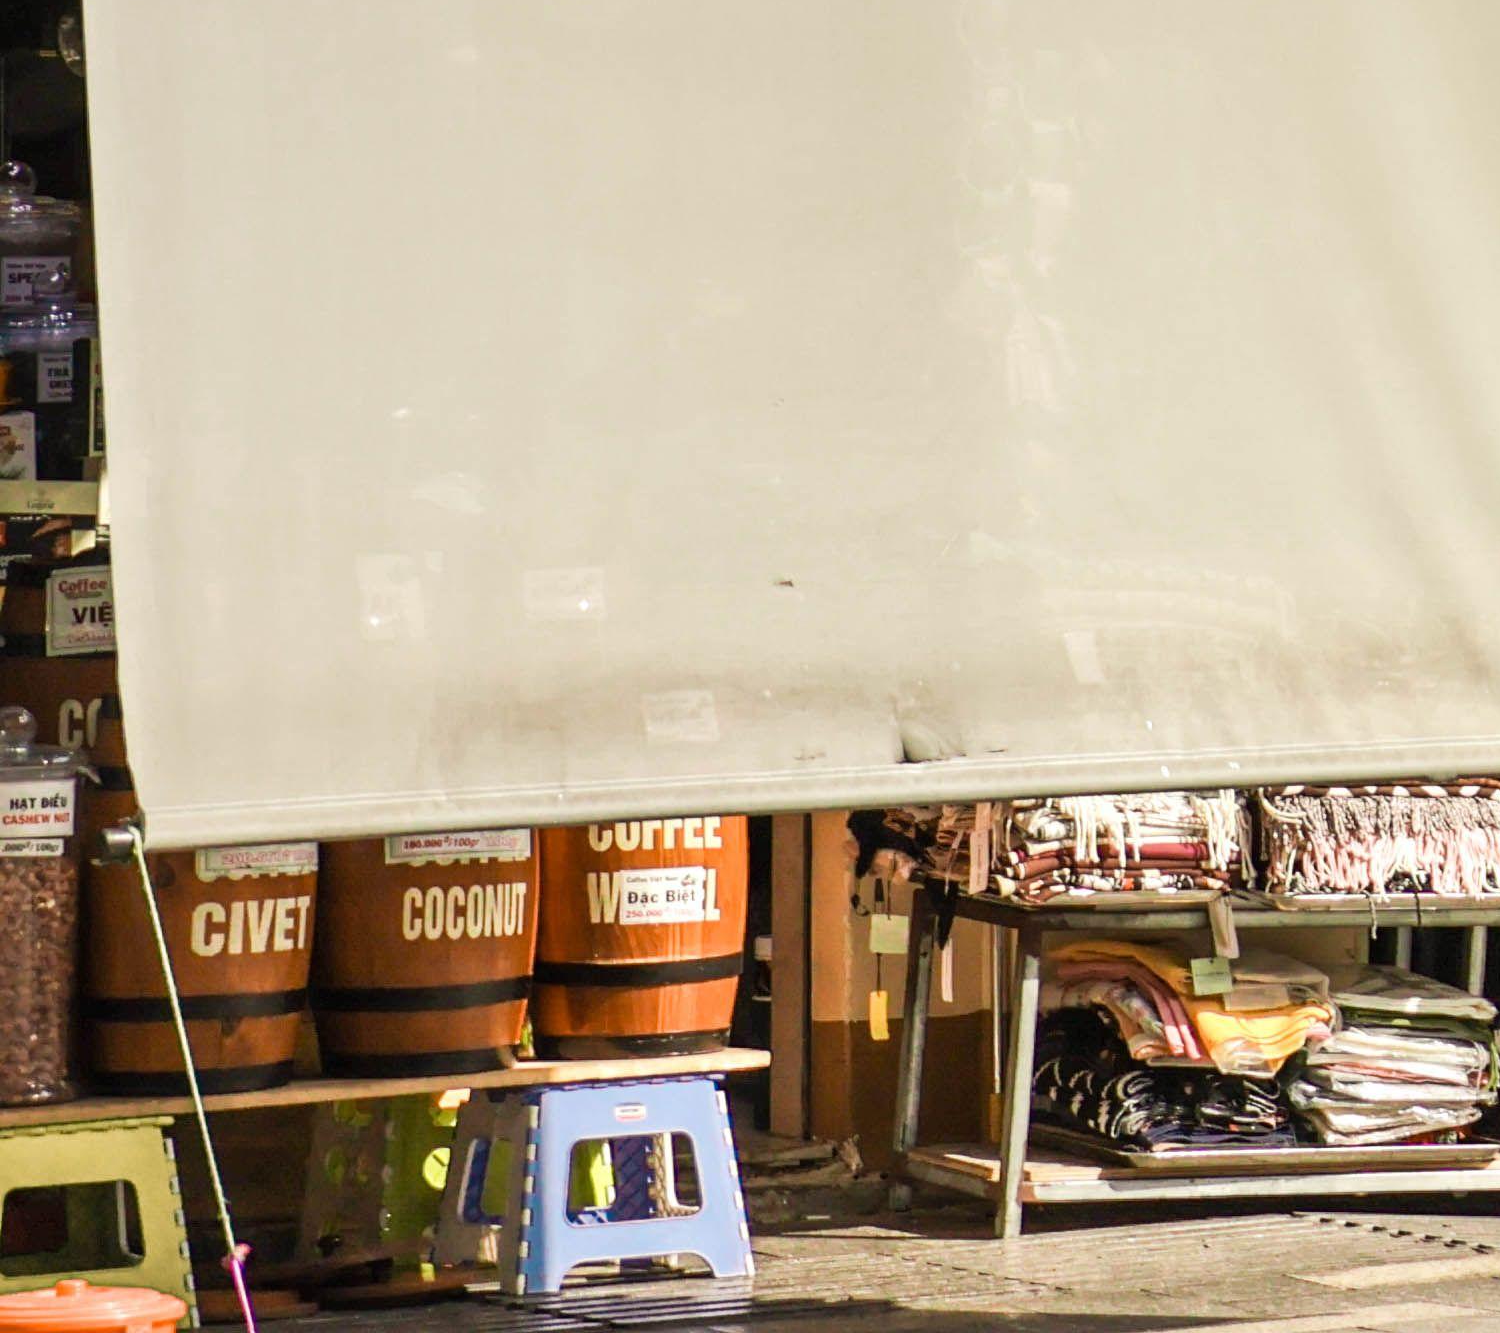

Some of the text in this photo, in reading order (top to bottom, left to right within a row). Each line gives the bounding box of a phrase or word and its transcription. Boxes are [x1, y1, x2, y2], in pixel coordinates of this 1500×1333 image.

[58, 578, 107, 595] Coffee
[2, 813, 50, 826] CASHEW
[628, 889, 696, 908] Đặc Biệt
[402, 883, 527, 941] COCONUT
[191, 896, 310, 957] CIVET
